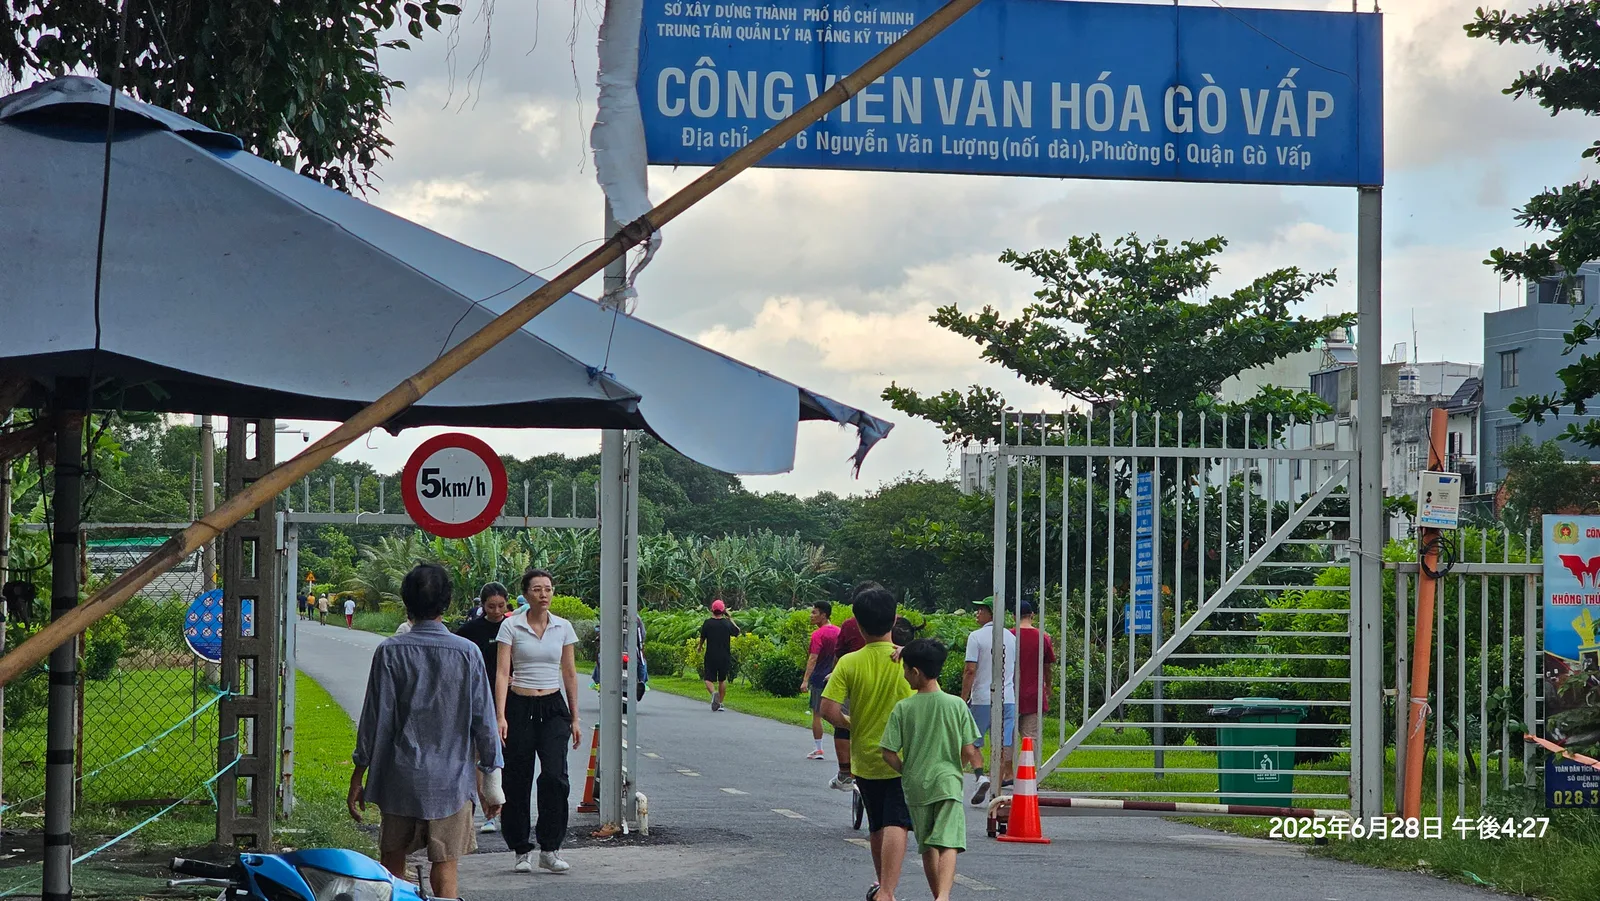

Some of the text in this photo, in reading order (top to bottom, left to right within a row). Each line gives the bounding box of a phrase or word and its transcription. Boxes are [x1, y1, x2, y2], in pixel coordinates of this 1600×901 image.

[685, 1, 711, 17] XÂY
[755, 5, 797, 21] THÀNH
[803, 4, 830, 22] PHỐ
[834, 5, 851, 23] HỒ
[854, 8, 877, 24] CHÍ
[880, 11, 914, 25] MINH
[657, 23, 700, 38] TRUNG
[704, 22, 732, 39] TÂM
[736, 22, 771, 41] QUẢN
[774, 25, 790, 41] LÝ
[795, 29, 812, 44] HẠ
[816, 24, 851, 43] TẦNG
[854, 28, 871, 44] KỸ
[657, 56, 794, 121] CÔNG
[933, 67, 1032, 128] VĂN
[1051, 71, 1150, 132] HÓA
[1164, 73, 1227, 134] GÒ
[1240, 67, 1335, 138] VẤP
[682, 126, 713, 151] Địa
[817, 128, 888, 156] Nguyễn
[896, 133, 933, 154] Văn
[1187, 143, 1234, 168] Quận
[1243, 145, 1267, 166] Gò
[1276, 143, 1311, 170] Vấp
[421, 467, 486, 499] 5km/h
[1552, 592, 1582, 605] KHÔNG
[1553, 790, 1584, 805] 028
